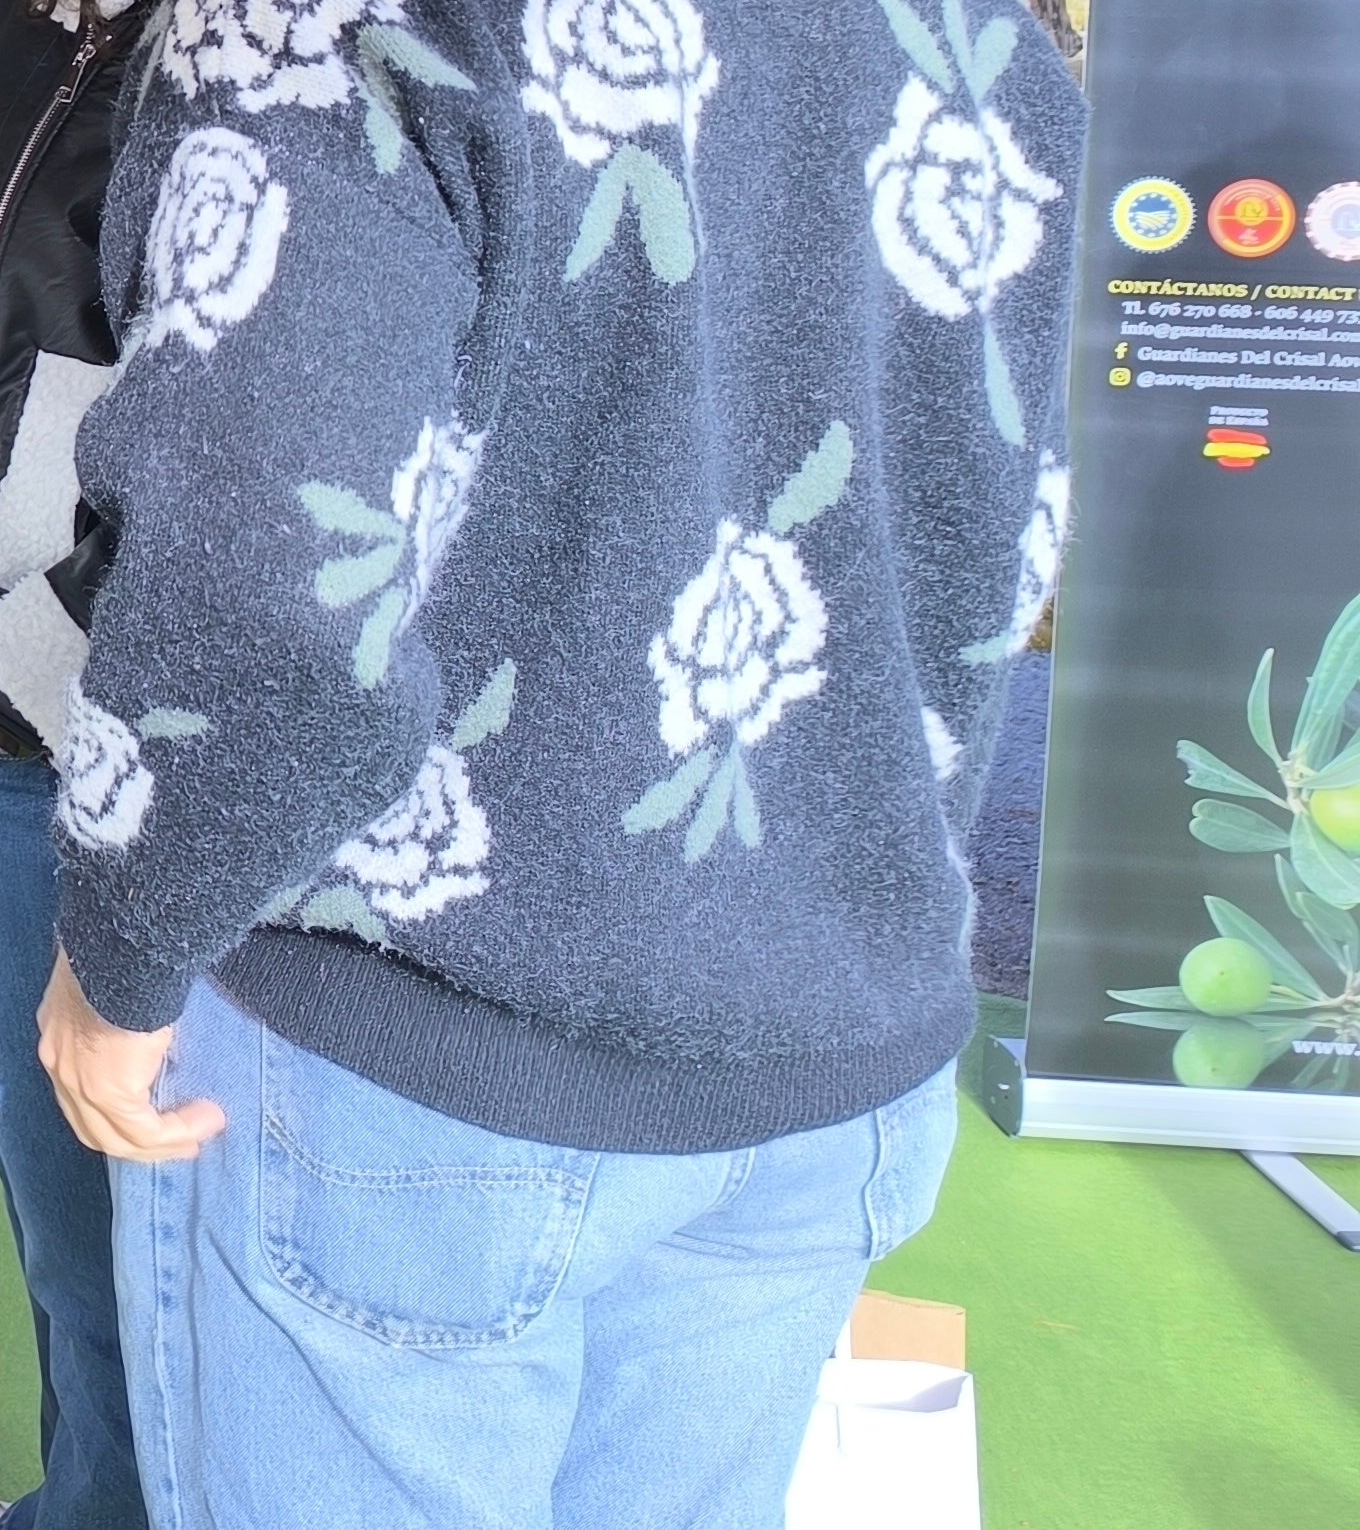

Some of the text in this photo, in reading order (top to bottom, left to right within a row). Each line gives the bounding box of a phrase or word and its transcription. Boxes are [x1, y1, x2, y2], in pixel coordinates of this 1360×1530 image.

[1108, 279, 1249, 299] CONTÁCTANOS
[1265, 285, 1356, 301] CONTACT
[1148, 302, 1181, 318] 676
[1183, 304, 1217, 319] 270
[1218, 305, 1252, 319] 668
[1264, 306, 1298, 320] 606
[1299, 309, 1335, 323] 449
[1137, 347, 1238, 364] Guardianes
[1241, 351, 1270, 365] Del
[1273, 352, 1326, 366] Crisal
